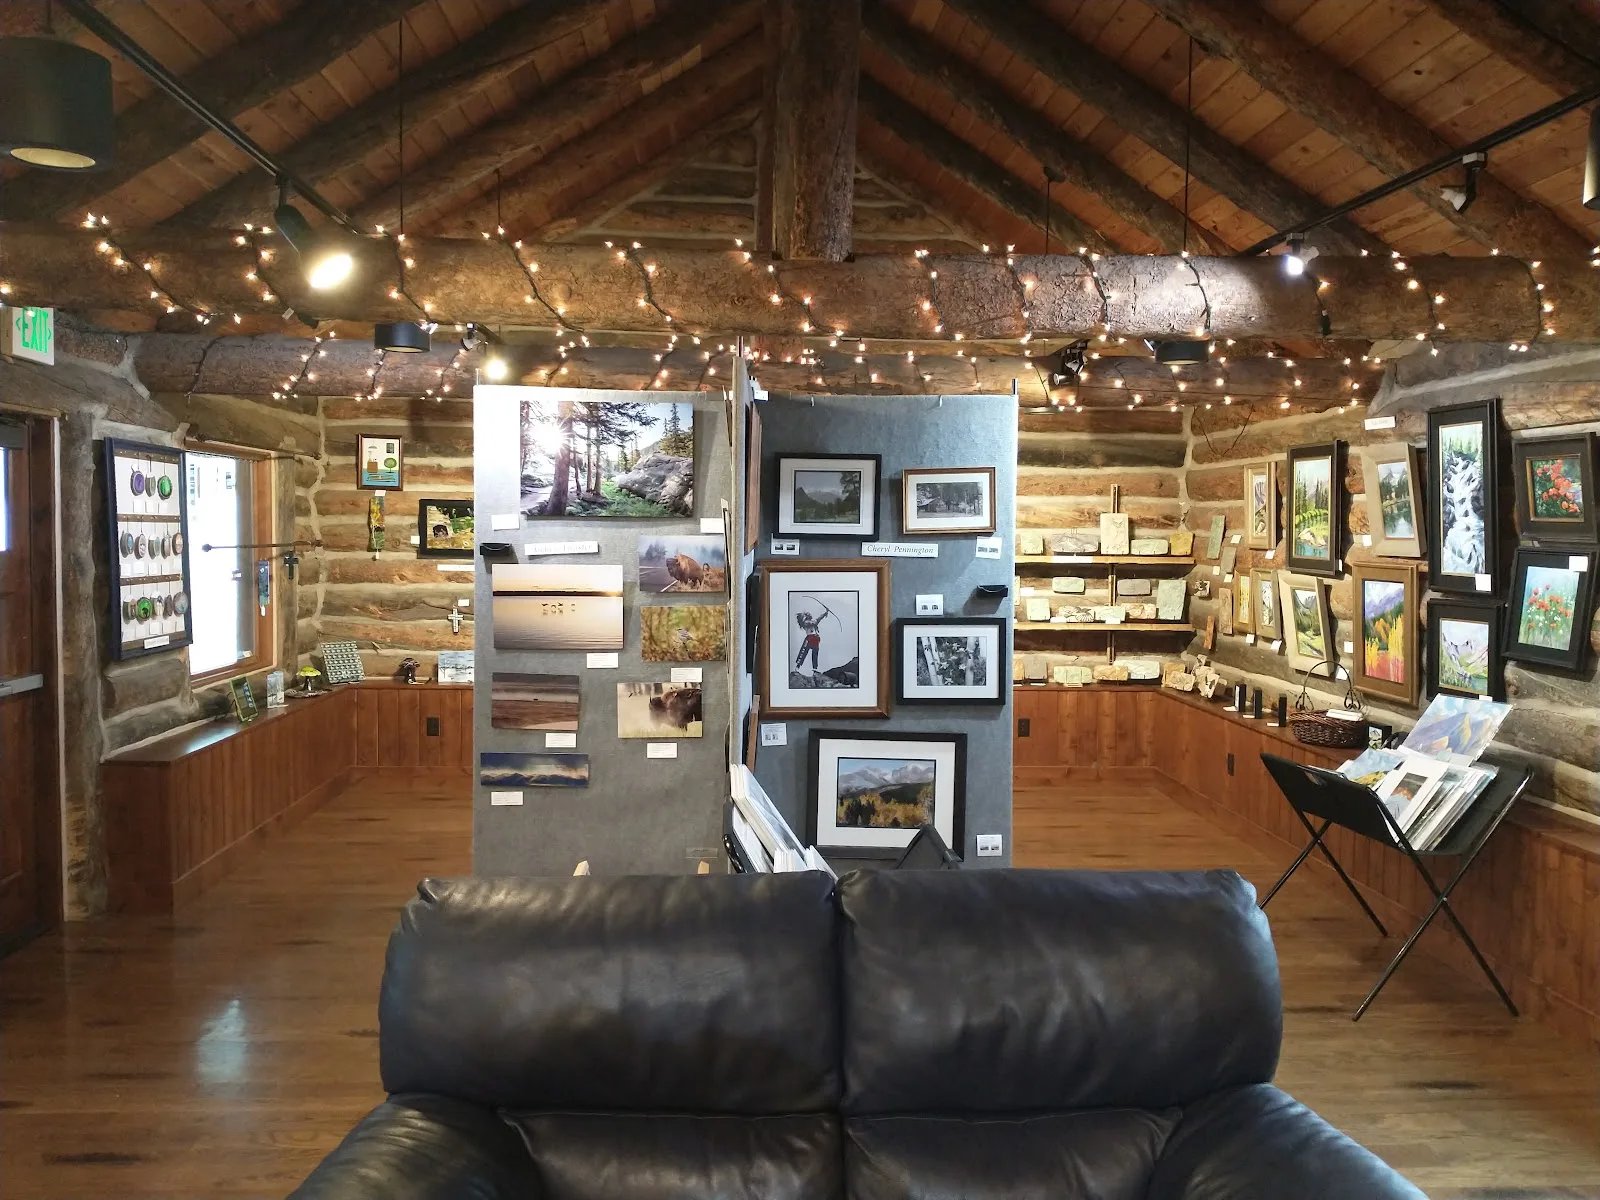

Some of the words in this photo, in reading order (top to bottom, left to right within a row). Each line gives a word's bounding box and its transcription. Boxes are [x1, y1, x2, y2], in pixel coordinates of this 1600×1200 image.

[22, 307, 48, 353] EXIT
[867, 544, 891, 554] Cheryl
[894, 545, 934, 556] Pennington
